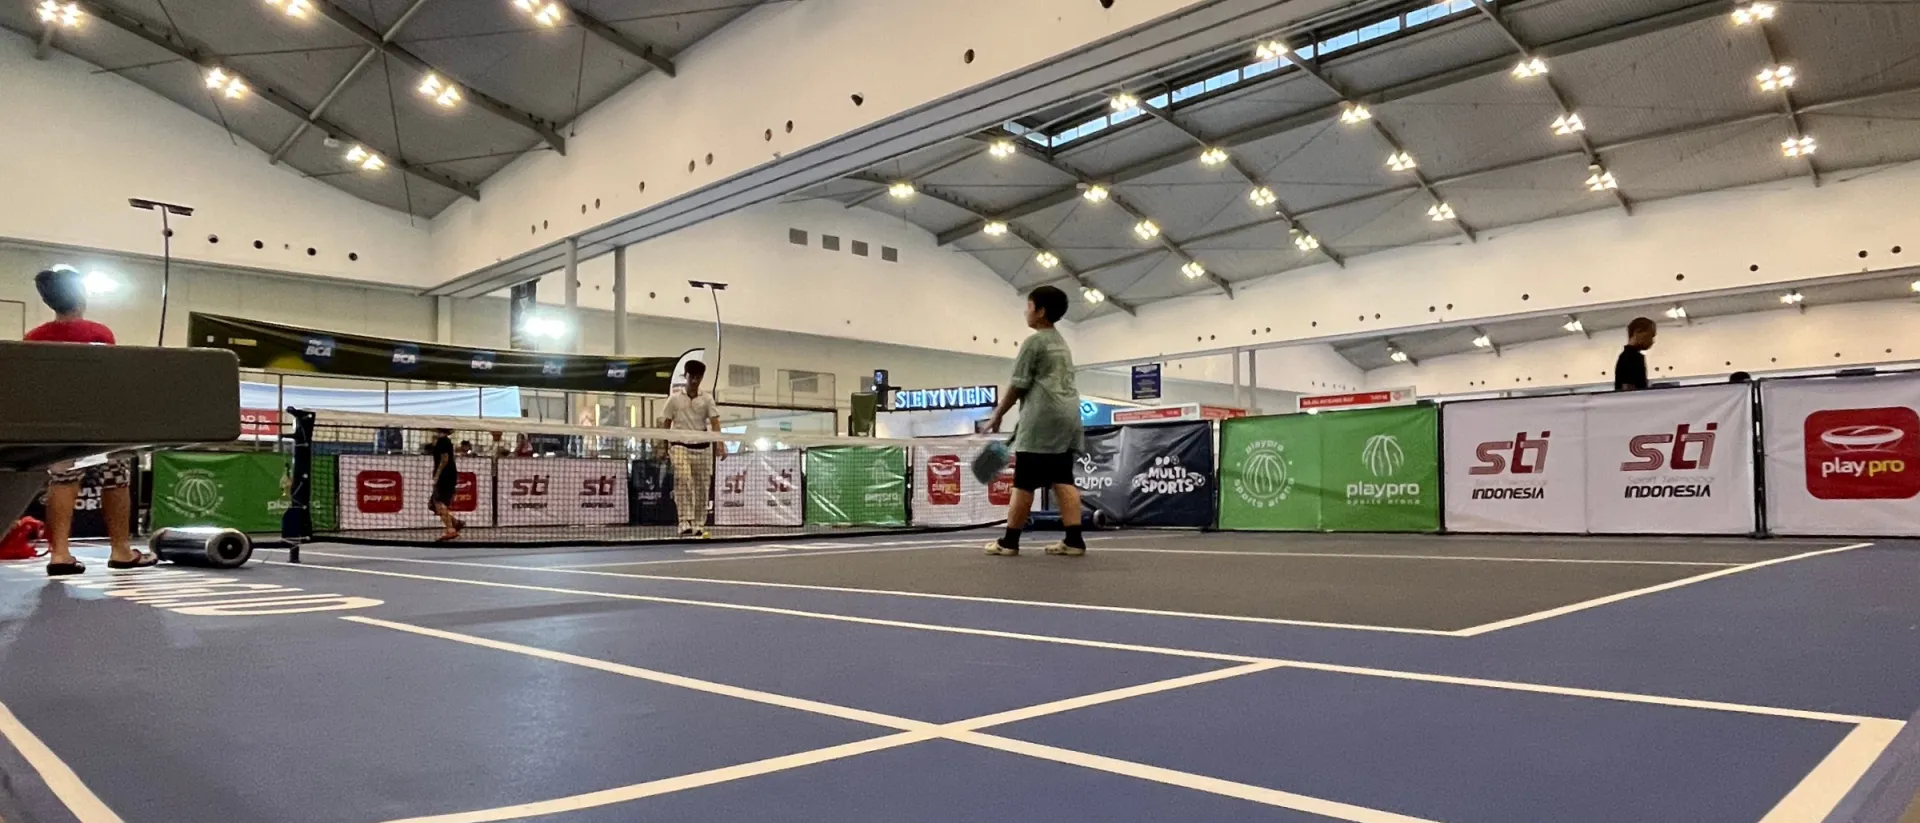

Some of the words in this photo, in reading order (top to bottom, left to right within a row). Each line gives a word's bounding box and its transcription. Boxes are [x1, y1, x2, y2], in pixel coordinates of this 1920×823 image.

[305, 346, 332, 358] BCA
[392, 353, 417, 364] BCA
[1245, 440, 1284, 455] playpro
[1468, 431, 1550, 475] sti
[1620, 423, 1718, 472] sti
[1148, 466, 1186, 479] MULTI
[1821, 456, 1866, 478] play
[1869, 460, 1905, 477] pro
[1074, 476, 1113, 489] aypro
[1141, 479, 1194, 494] SPORTS
[1346, 480, 1420, 498] playpro
[1234, 478, 1264, 509] sports
[1267, 477, 1296, 508] arena
[1472, 487, 1544, 499] INDONESIA
[1625, 485, 1710, 498] INDONESIA
